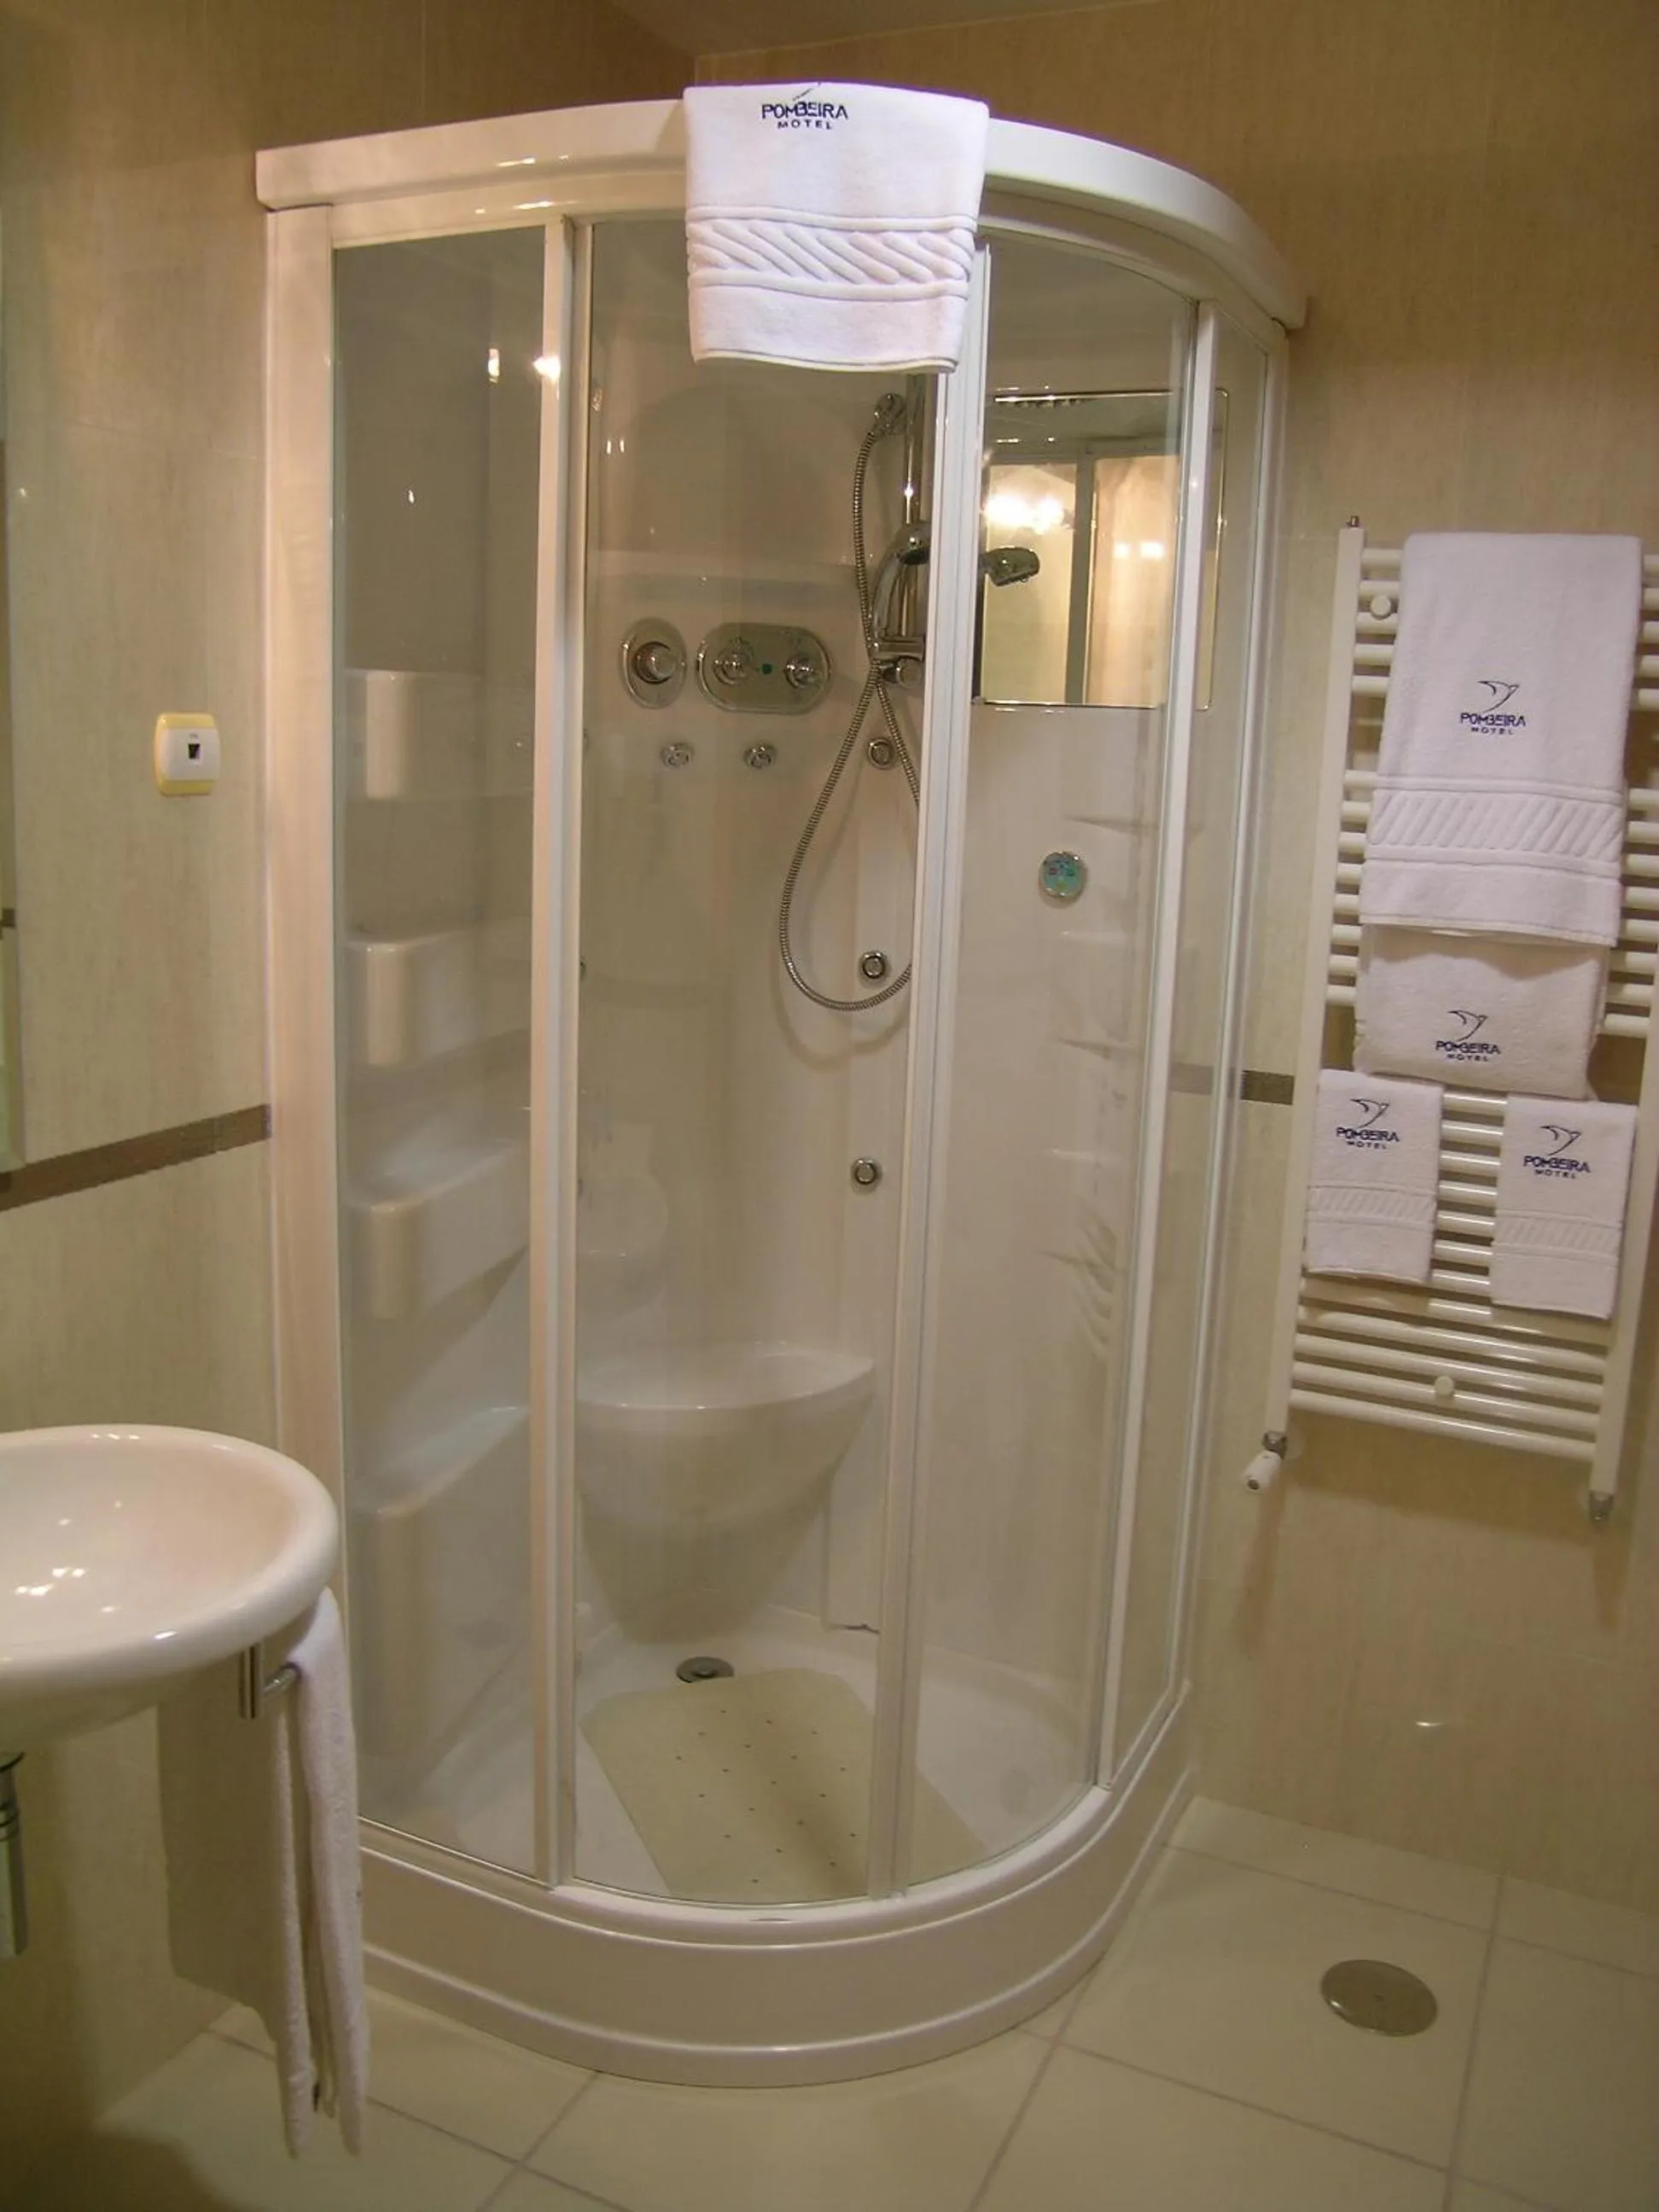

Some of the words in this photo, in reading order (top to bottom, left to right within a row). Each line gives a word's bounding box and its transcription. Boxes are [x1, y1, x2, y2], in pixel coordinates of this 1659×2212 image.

[761, 102, 848, 119] POMBEIRA
[777, 119, 832, 130] MOTEL
[1460, 712, 1526, 727] POMBEIRA
